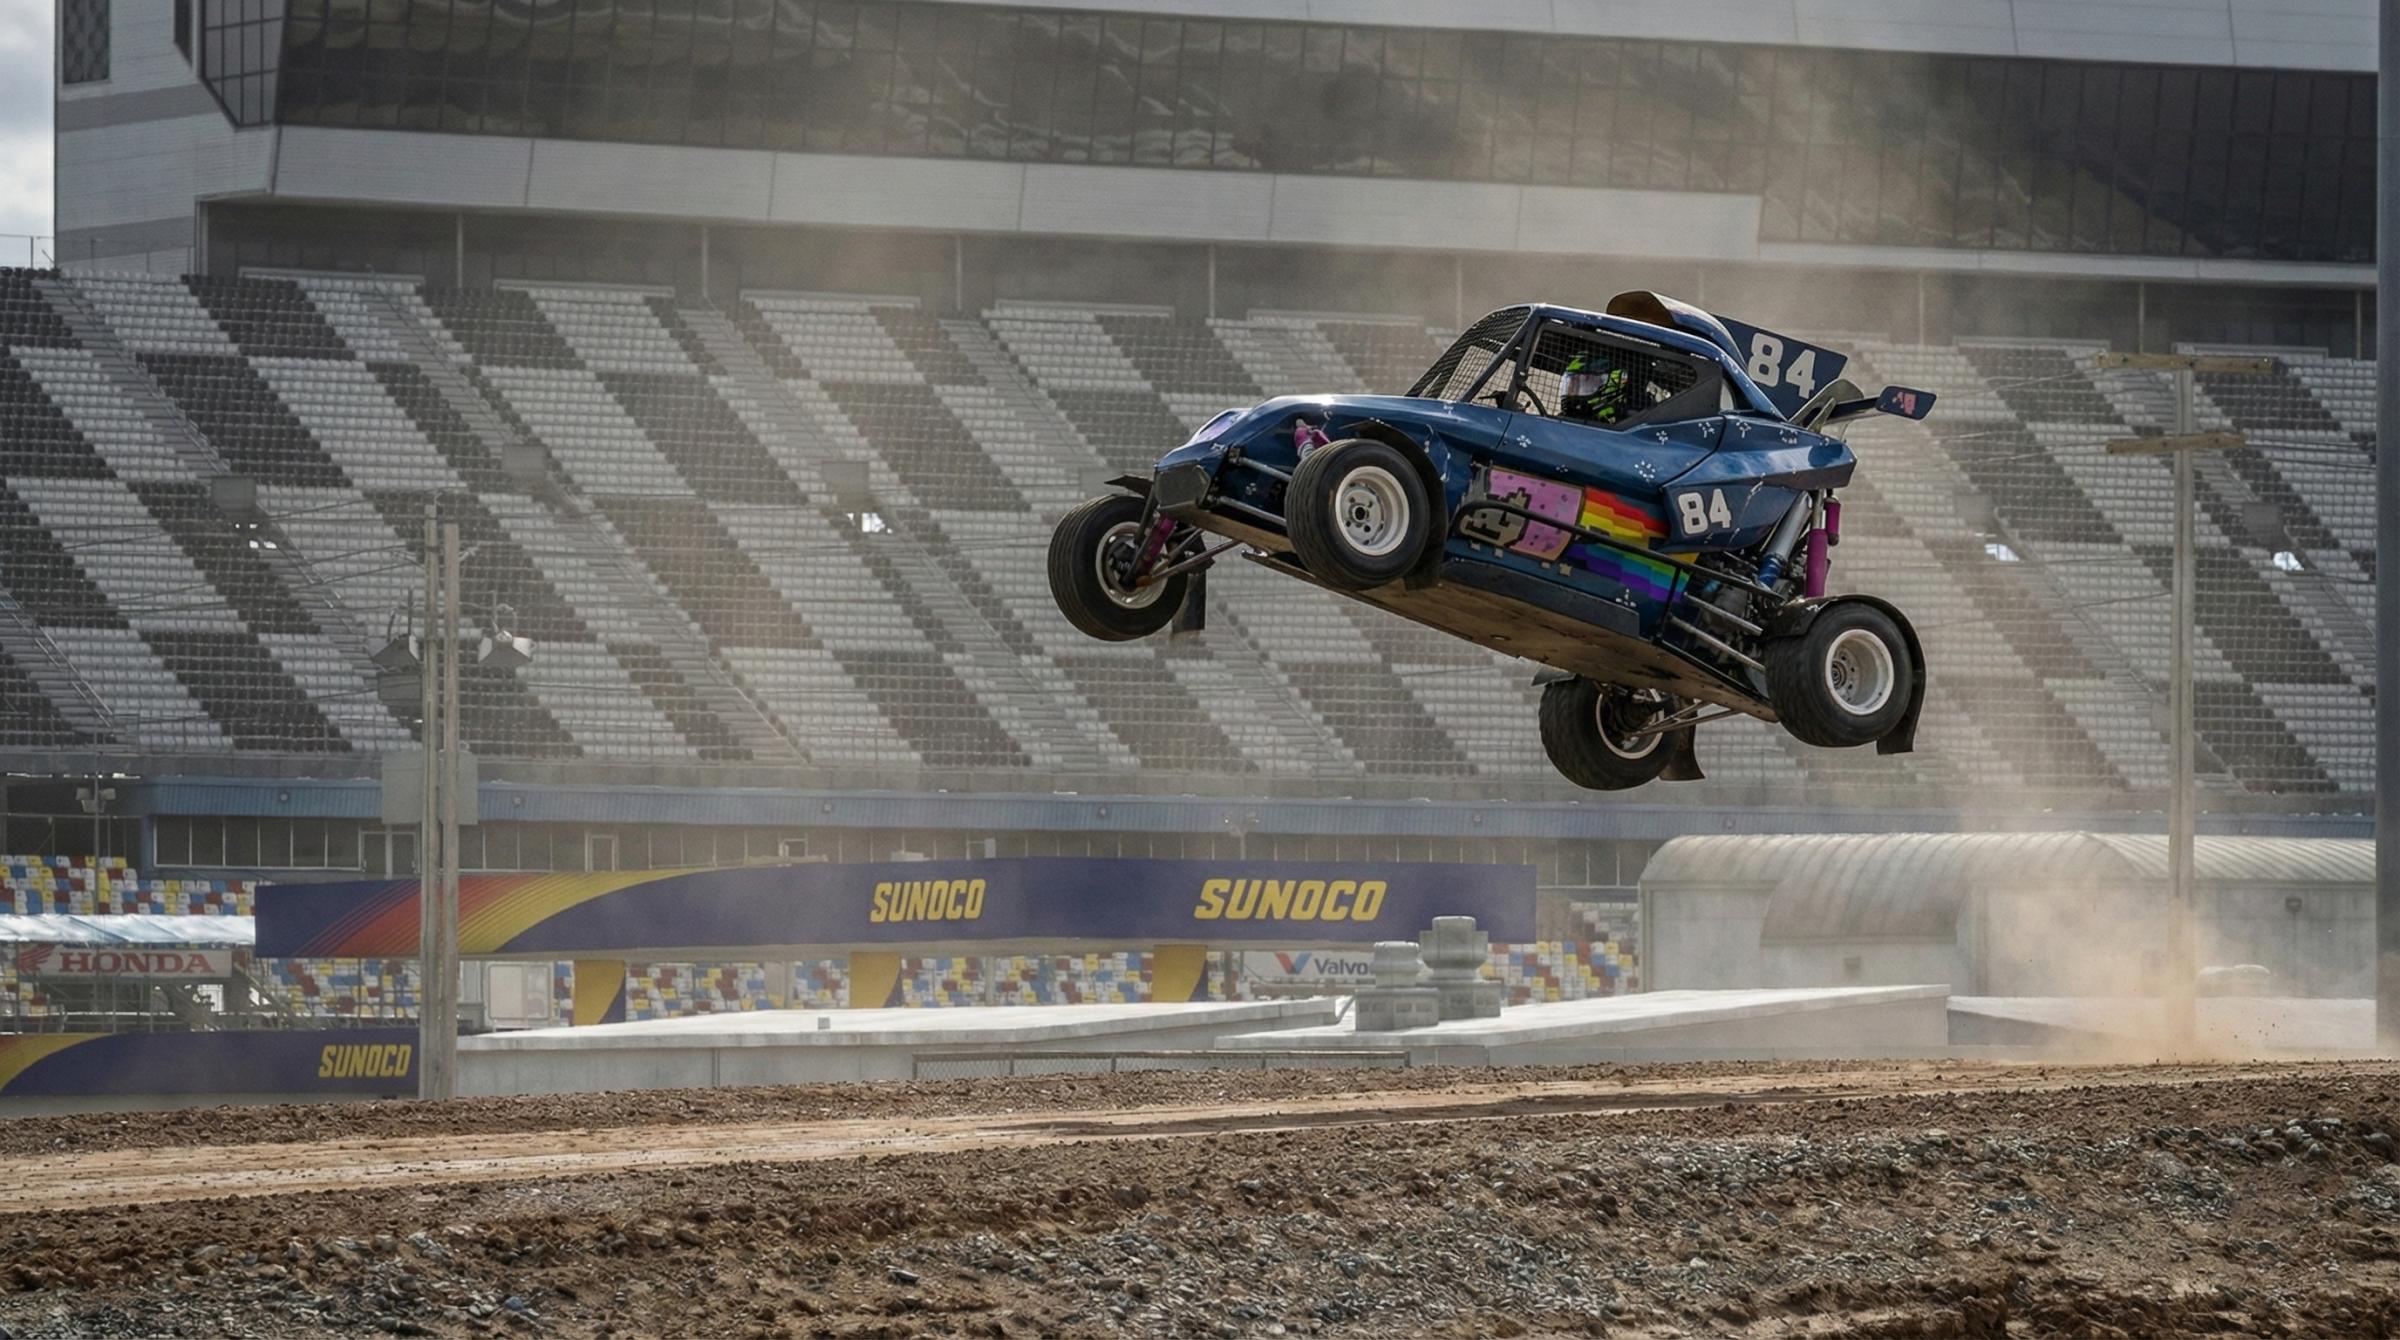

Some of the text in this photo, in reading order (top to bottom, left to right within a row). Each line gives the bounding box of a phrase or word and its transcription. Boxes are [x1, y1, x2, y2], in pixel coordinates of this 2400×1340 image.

[1747, 332, 1816, 399] 84
[1678, 488, 1731, 534] 84
[870, 879, 986, 922] SUNOCO
[1194, 879, 1387, 921] SUNOCO
[58, 952, 215, 974] HONDA
[1314, 958, 1375, 976] Valvo
[318, 1044, 412, 1078] SUNOCO
